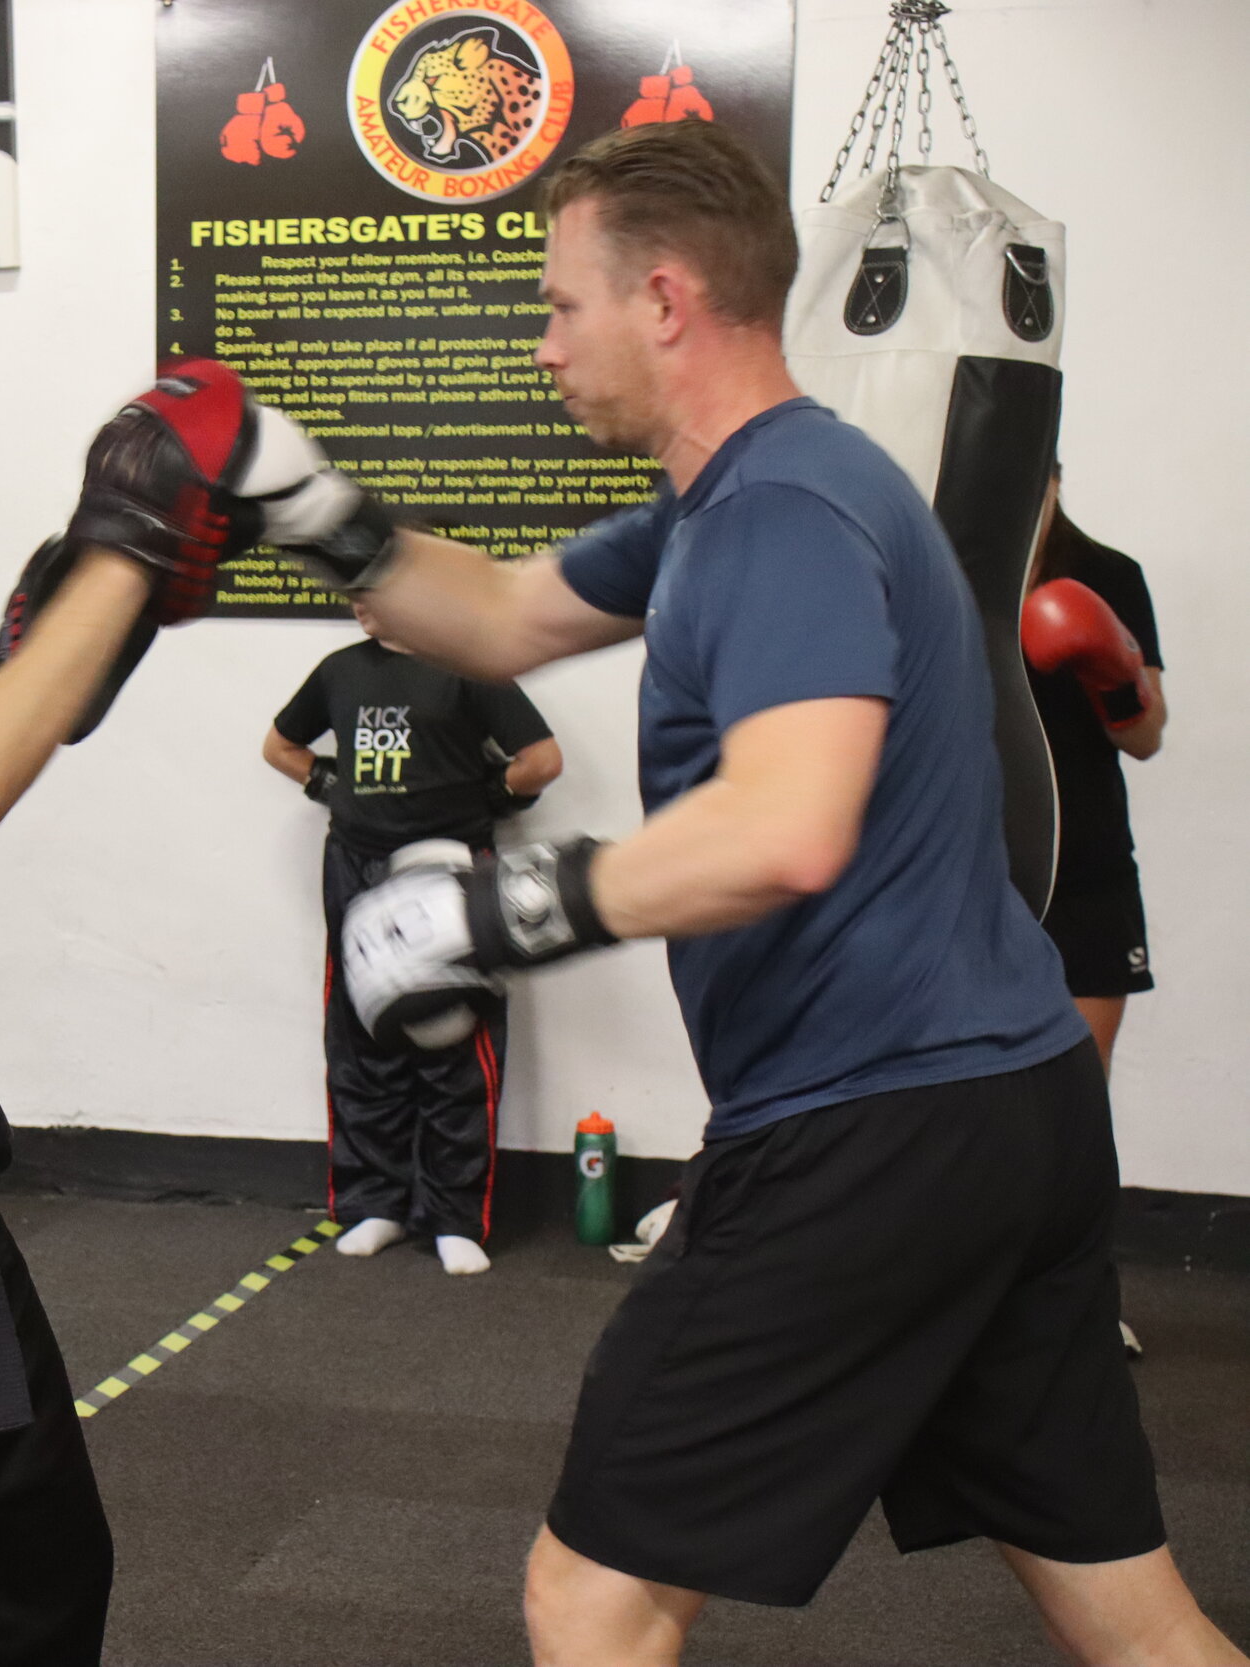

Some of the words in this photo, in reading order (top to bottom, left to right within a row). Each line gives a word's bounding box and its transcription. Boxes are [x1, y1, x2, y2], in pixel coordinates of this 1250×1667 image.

[357, 95, 430, 192] AMATEUR
[443, 150, 540, 197] BOXING
[540, 80, 572, 143] CLUB
[191, 212, 486, 247] FISHERSGATE'S
[496, 211, 547, 239] CL
[170, 258, 184, 270] 1.
[261, 255, 316, 269] Respect
[318, 256, 349, 270] your
[351, 253, 393, 267] fellow
[169, 274, 184, 288] 2.
[215, 273, 262, 287] Please
[263, 272, 314, 287] respect
[316, 271, 340, 284] the
[341, 270, 388, 286] boxing
[426, 268, 444, 282] all
[446, 268, 465, 281] its
[215, 290, 267, 305] making
[268, 291, 300, 303] sure
[301, 291, 326, 305] you
[328, 289, 366, 302] leave
[367, 288, 378, 300] it
[380, 289, 398, 300] as
[400, 289, 425, 303] you
[427, 286, 455, 299] find
[169, 308, 184, 321] 3.
[215, 307, 235, 320] No
[237, 307, 275, 320] boxer
[276, 306, 301, 319] will
[303, 306, 321, 319] be
[323, 304, 385, 321] expected
[387, 305, 403, 318] to
[441, 303, 482, 317] under
[484, 304, 511, 318] any
[215, 324, 233, 337] do
[170, 342, 184, 354] 4.
[215, 341, 273, 356] Sparring
[274, 340, 299, 353] will
[300, 340, 330, 355] only
[331, 339, 363, 352] take
[365, 339, 403, 354] place
[418, 338, 436, 351] all
[439, 337, 507, 352] protective
[295, 356, 374, 371] appropriate
[376, 357, 421, 371] gloves
[423, 355, 450, 368] and
[452, 354, 488, 370] groin
[293, 374, 308, 386] to
[310, 373, 328, 386] be
[330, 372, 404, 388] supervised
[407, 373, 423, 387] by
[426, 374, 436, 385] a
[438, 371, 499, 386] qualified
[502, 371, 539, 384] Level
[541, 370, 552, 384] 2
[282, 391, 309, 404] and
[311, 391, 346, 405] keep
[348, 389, 389, 403] fitters
[391, 389, 427, 402] must
[429, 389, 476, 404] please
[478, 388, 528, 401] adhere
[530, 388, 546, 401] to
[307, 424, 390, 439] promotional
[392, 424, 422, 438] tops
[535, 422, 550, 435] to
[553, 421, 572, 435] be
[333, 459, 358, 471] you
[361, 459, 384, 470] are
[386, 458, 426, 473] solely
[428, 457, 508, 472] responsible
[511, 456, 531, 470] for
[533, 458, 564, 473] your
[567, 456, 629, 472] personal
[352, 474, 419, 489] onsibility
[421, 474, 441, 487] for
[539, 475, 554, 487] to
[556, 475, 587, 489] your
[381, 491, 400, 504] be
[402, 491, 464, 504] tolerated
[467, 491, 494, 504] and
[497, 490, 521, 504] will
[524, 490, 564, 504] result
[567, 490, 581, 504] in
[584, 490, 607, 504] the
[449, 525, 490, 538] which
[492, 527, 518, 540] you
[521, 525, 547, 538] feel
[550, 527, 576, 540] you
[490, 541, 505, 555] of
[508, 542, 532, 555] the
[234, 574, 285, 589] Nobody
[287, 574, 299, 588] is
[216, 590, 290, 604] Remember
[293, 590, 311, 604] all
[312, 591, 327, 604] at
[357, 705, 411, 728] KICK
[354, 728, 411, 750] BOX
[354, 750, 411, 783] FIT
[580, 1150, 604, 1179] G
